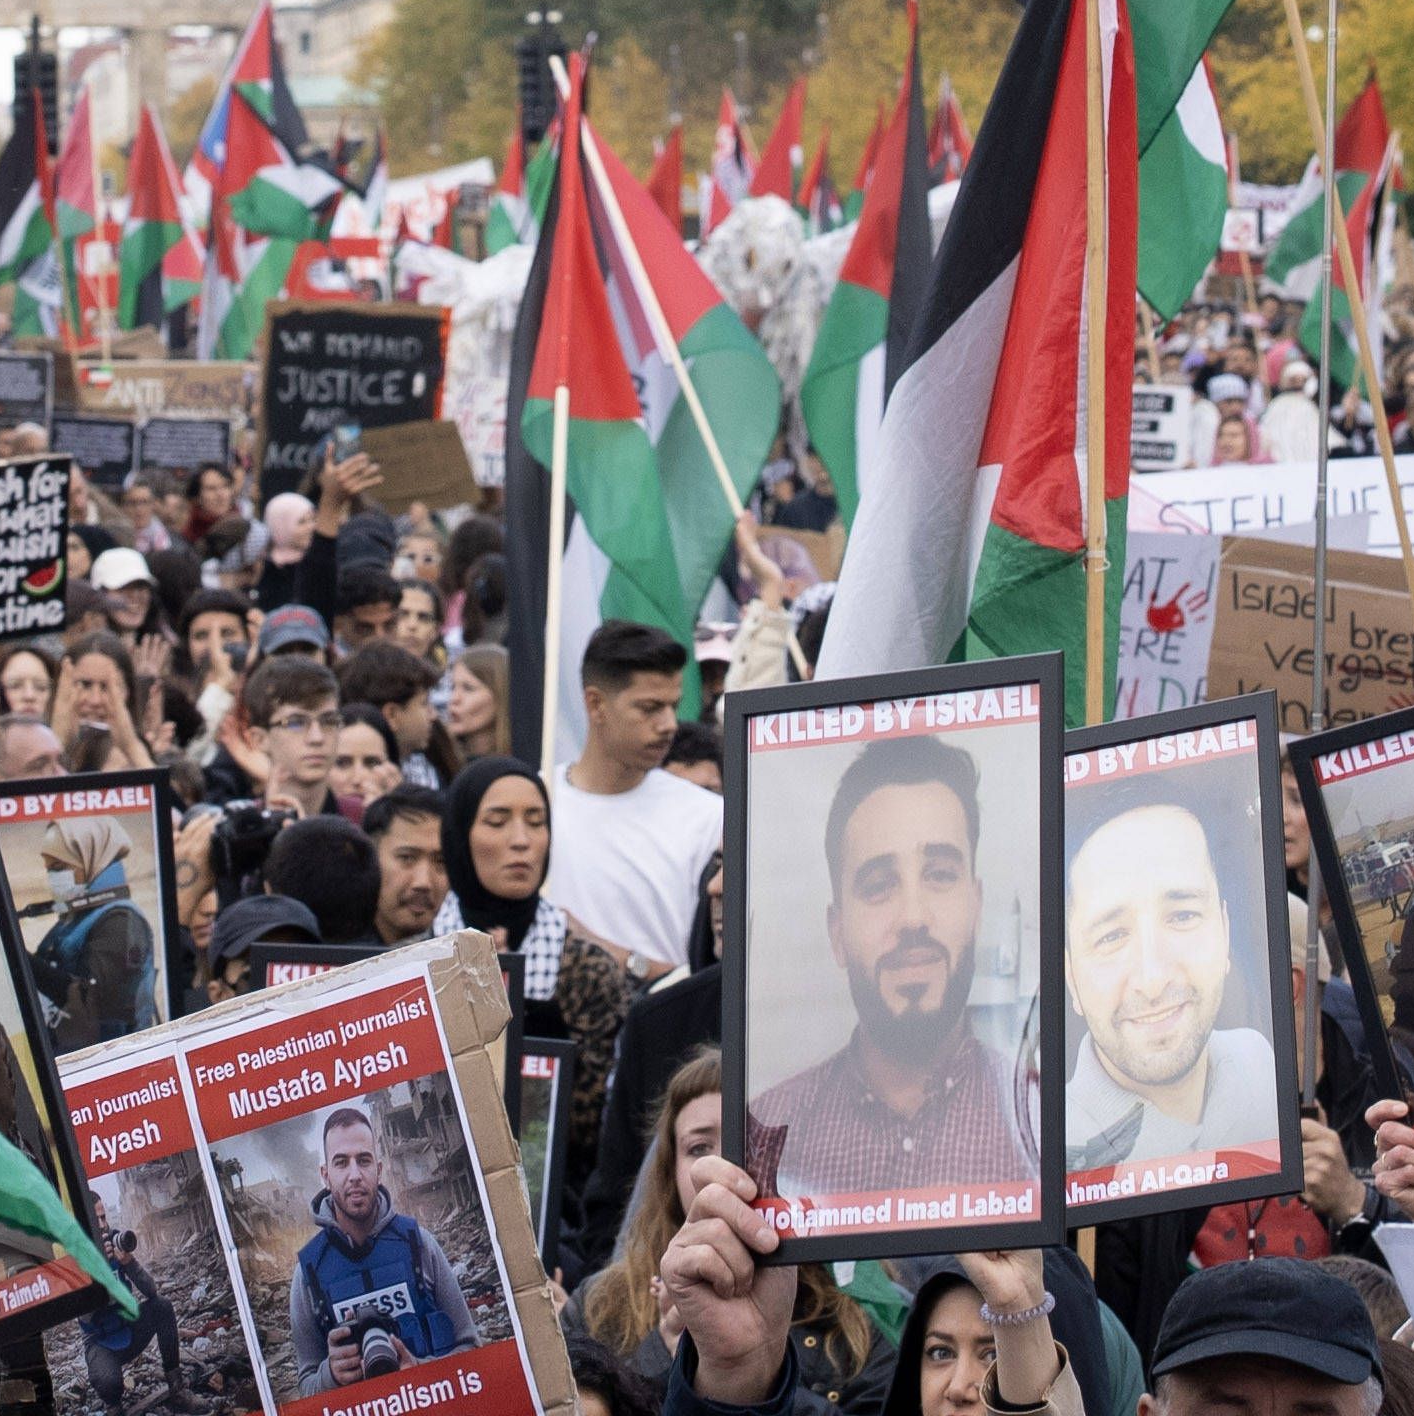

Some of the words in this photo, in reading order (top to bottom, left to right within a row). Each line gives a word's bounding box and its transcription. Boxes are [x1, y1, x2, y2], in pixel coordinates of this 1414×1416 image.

[277, 365, 406, 406] JUSTICE
[28, 462, 68, 504] for
[1233, 573, 1335, 622] Israel
[755, 704, 865, 746] KILLED
[873, 697, 918, 733] BY
[925, 684, 1039, 728] ISRAEL
[1098, 742, 1138, 776] BY
[1147, 719, 1255, 766] ISRAEL
[23, 794, 59, 815] BY
[63, 785, 149, 812] ISRAEL
[195, 1061, 236, 1088] Free
[237, 1025, 337, 1075] Palestinian
[338, 997, 428, 1046] journalist
[228, 1068, 327, 1120] Mustafa
[333, 1041, 409, 1090] Ayash
[523, 1056, 554, 1075] EL
[70, 1104, 93, 1126] an
[95, 1076, 178, 1125] journalist
[89, 1119, 161, 1165] Ayash
[1140, 1159, 1229, 1191] Al-Qara
[757, 1197, 891, 1231] Mohammed
[897, 1192, 957, 1221] Imad
[962, 1188, 1033, 1218] Labad
[0, 1274, 51, 1311] Taimeh
[457, 1369, 483, 1396] is
